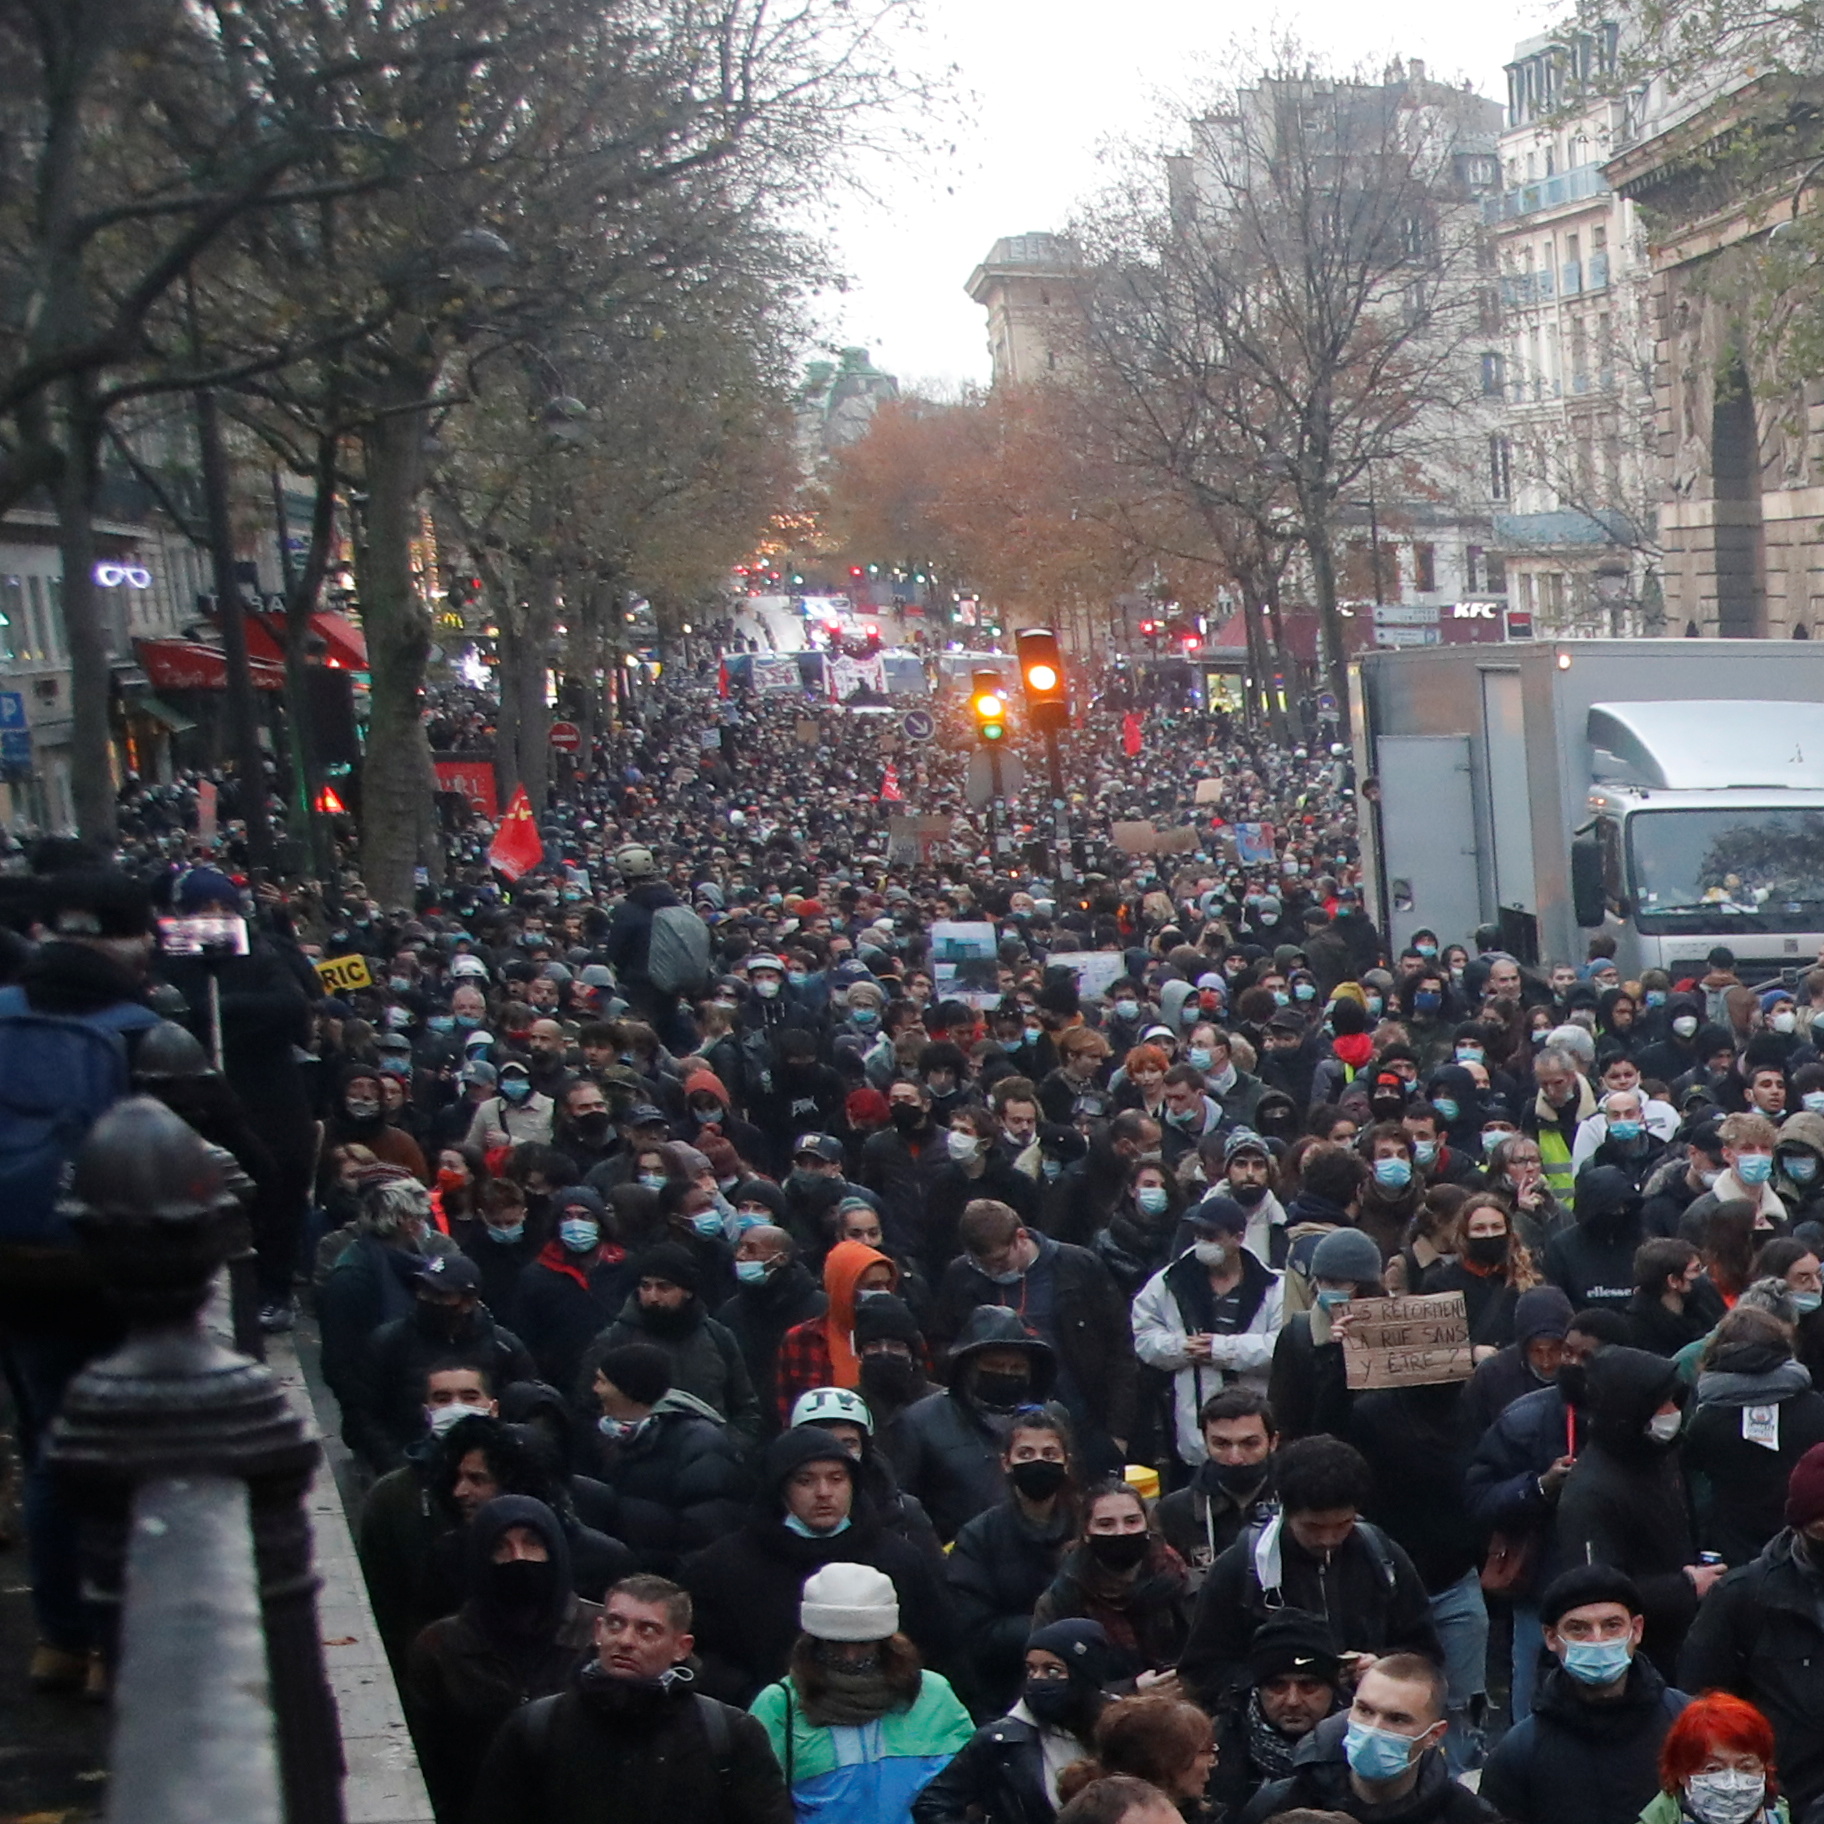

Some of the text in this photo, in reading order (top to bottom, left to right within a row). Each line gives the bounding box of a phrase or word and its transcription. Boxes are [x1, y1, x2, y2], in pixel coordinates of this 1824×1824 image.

[1454, 602, 1498, 619] KFC
[319, 961, 367, 990] RIC
[1586, 1285, 1632, 1298] ellesse
[1380, 1327, 1410, 1348] RUE
[1422, 1325, 1468, 1344] SANS
